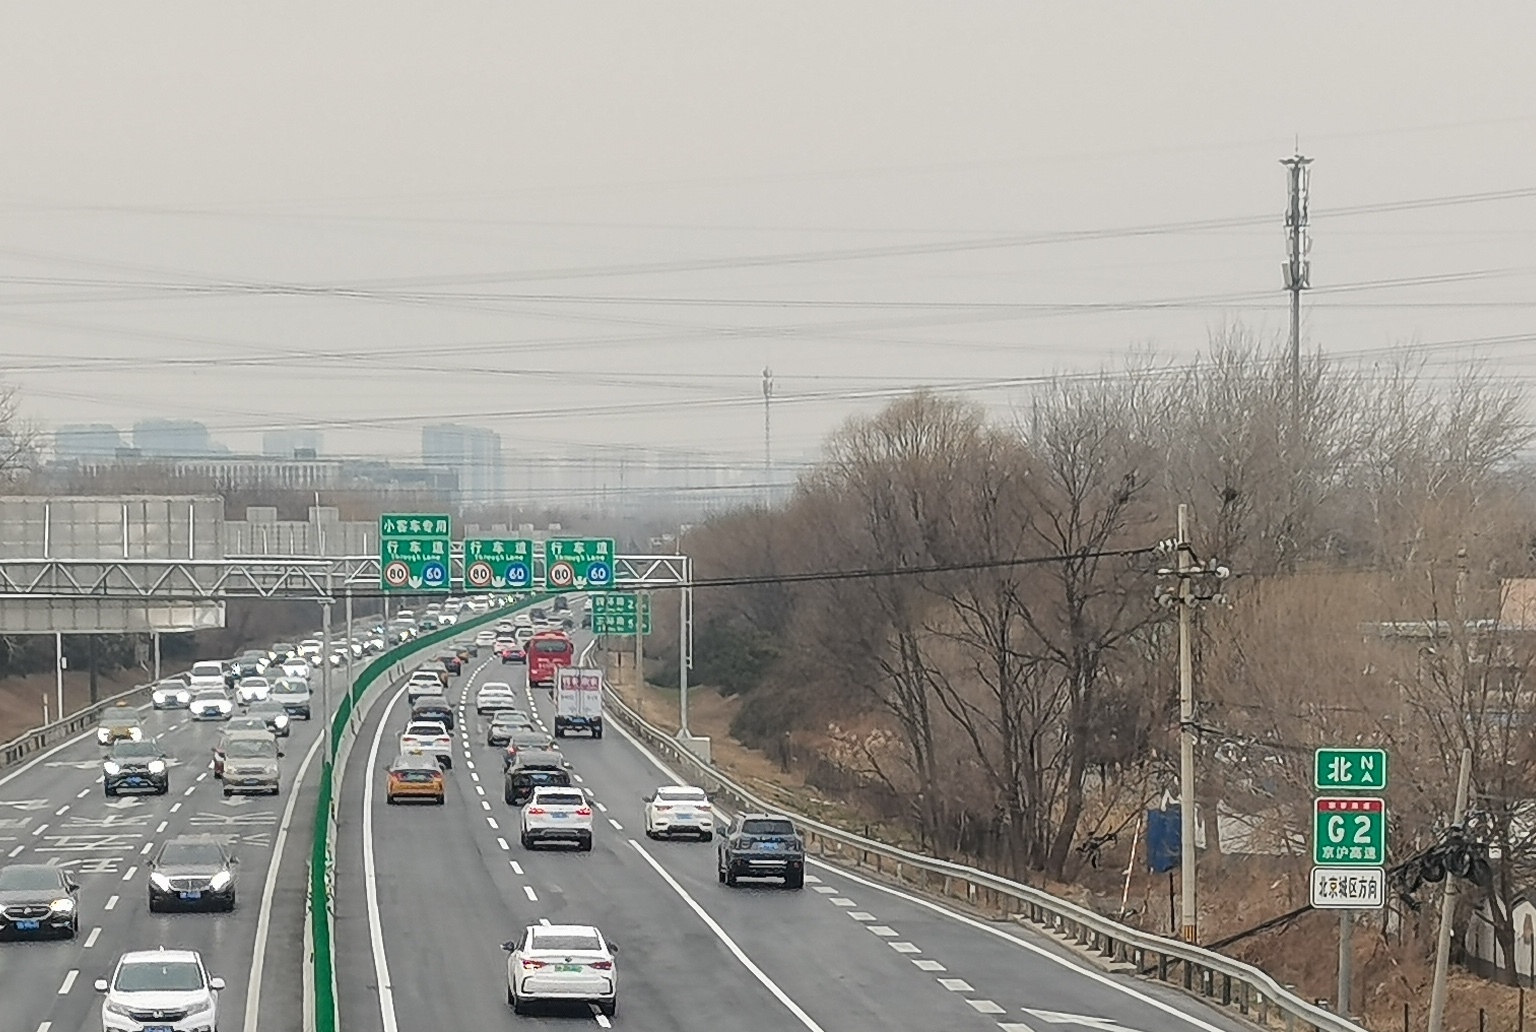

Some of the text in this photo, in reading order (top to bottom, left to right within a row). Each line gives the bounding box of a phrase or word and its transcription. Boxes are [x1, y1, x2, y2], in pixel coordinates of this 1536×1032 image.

[389, 568, 404, 579] 80
[426, 567, 442, 579] 60
[473, 568, 487, 579] 80
[509, 567, 524, 579] 60
[591, 567, 606, 579] 60
[1327, 756, 1353, 783] 北
[1360, 755, 1374, 771] N
[1328, 815, 1371, 844] G2
[1322, 845, 1376, 859] 京沪高速
[1319, 875, 1377, 899] 北京城区方向
